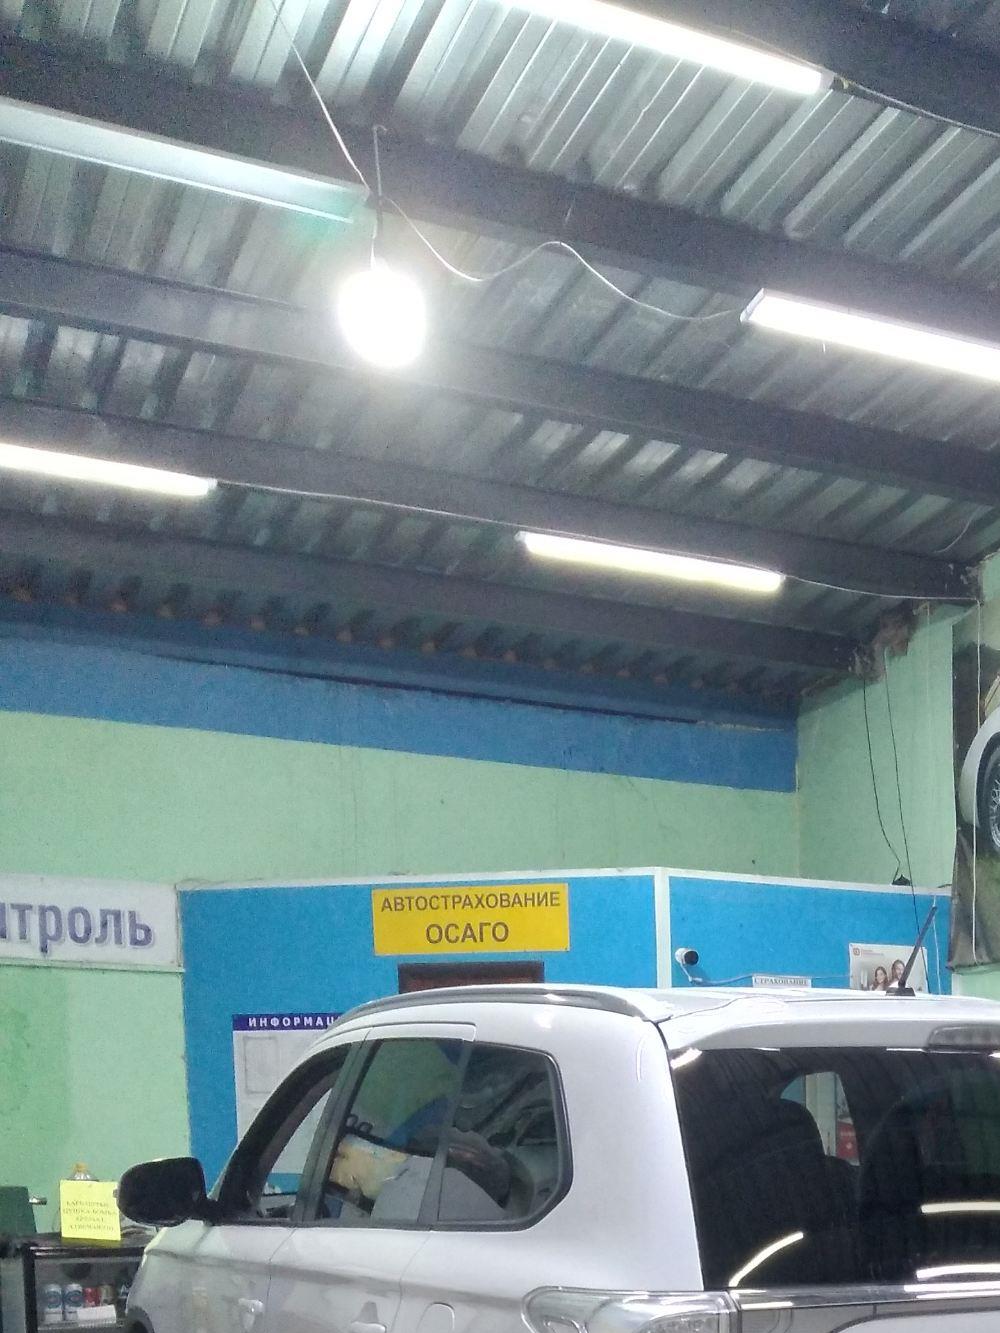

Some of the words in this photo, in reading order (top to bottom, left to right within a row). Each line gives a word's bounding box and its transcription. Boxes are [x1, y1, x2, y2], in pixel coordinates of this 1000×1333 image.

[381, 891, 561, 912] АВТОСТРАХОВАНИЕ
[426, 921, 509, 944] ОСАГО
[248, 1016, 341, 1028] ИНФОРМАЦ
